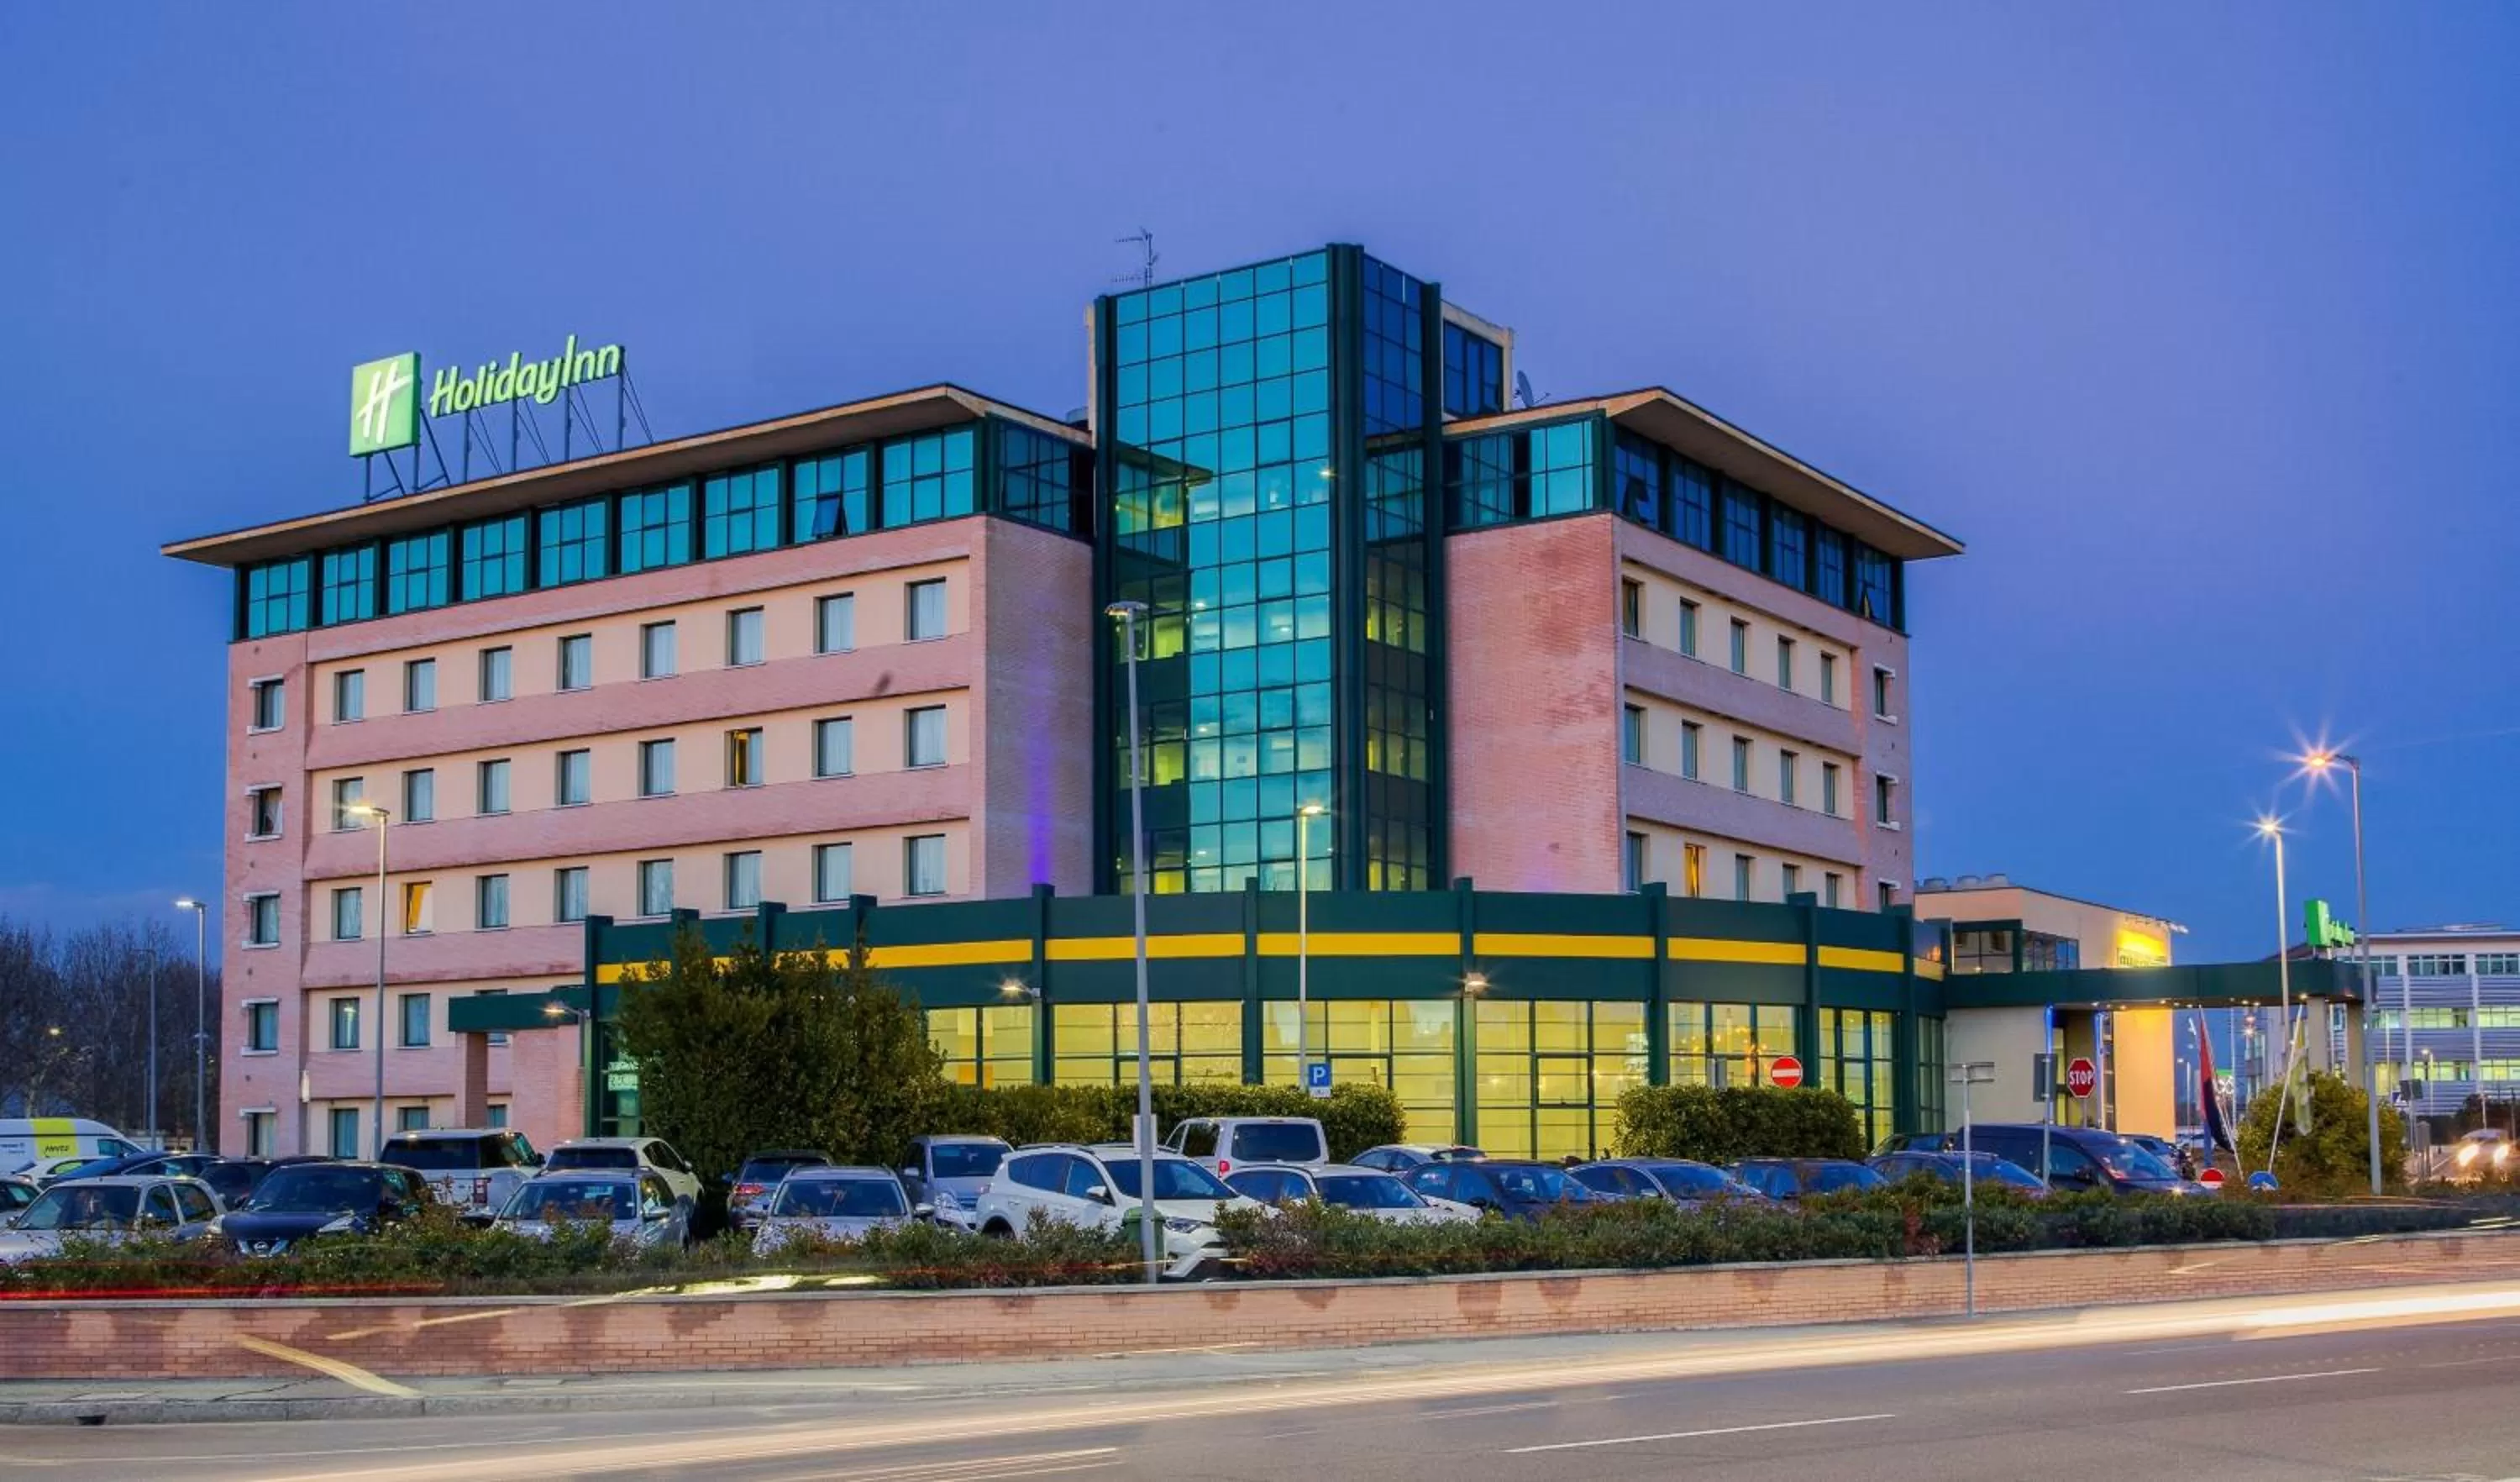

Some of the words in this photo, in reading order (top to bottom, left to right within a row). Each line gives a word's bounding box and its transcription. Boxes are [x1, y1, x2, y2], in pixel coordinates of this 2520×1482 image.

[429, 350, 562, 418] Holiday
[559, 334, 620, 387] Inn
[1313, 1066, 1326, 1085] P
[2069, 1069, 2094, 1085] STOP
